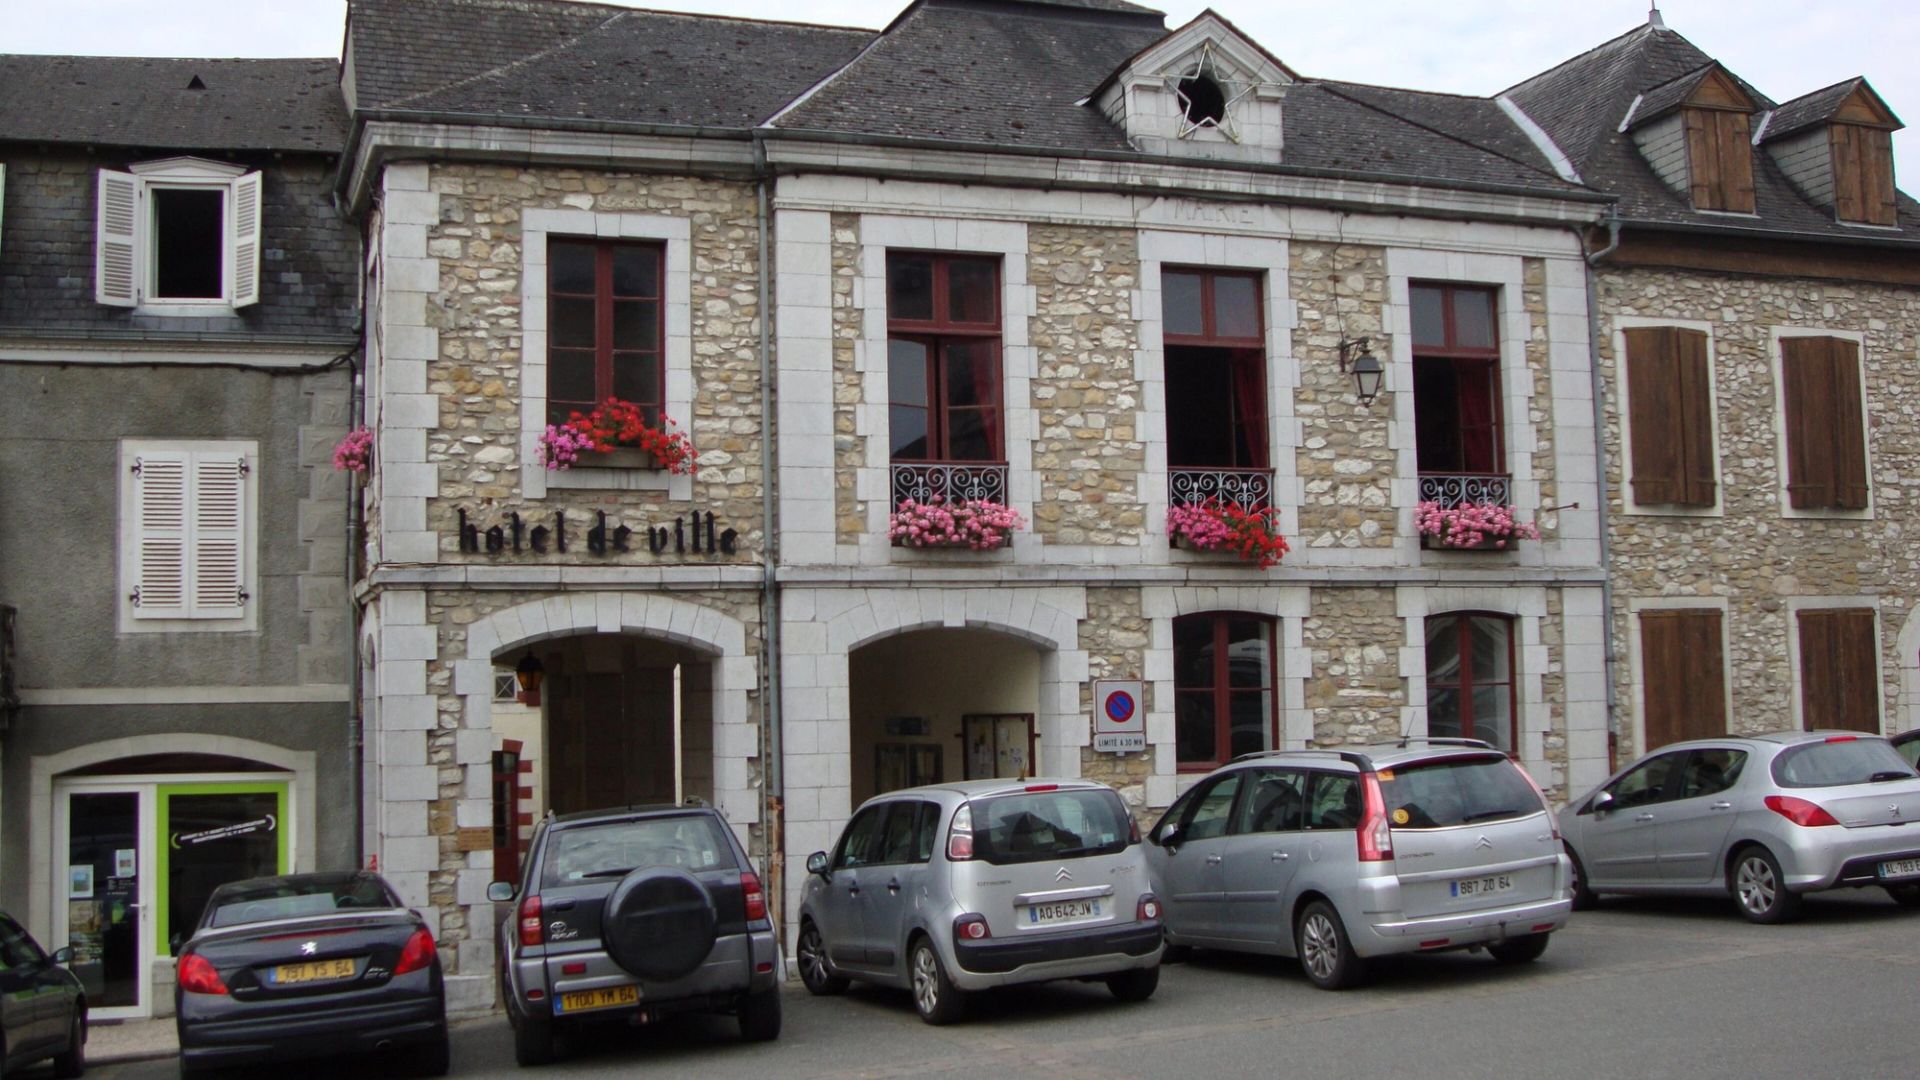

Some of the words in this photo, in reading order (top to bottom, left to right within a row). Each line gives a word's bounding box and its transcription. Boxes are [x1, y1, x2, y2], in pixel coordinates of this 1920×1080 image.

[587, 509, 632, 556] de
[647, 509, 739, 555] ville
[1499, 876, 1511, 889] 64
